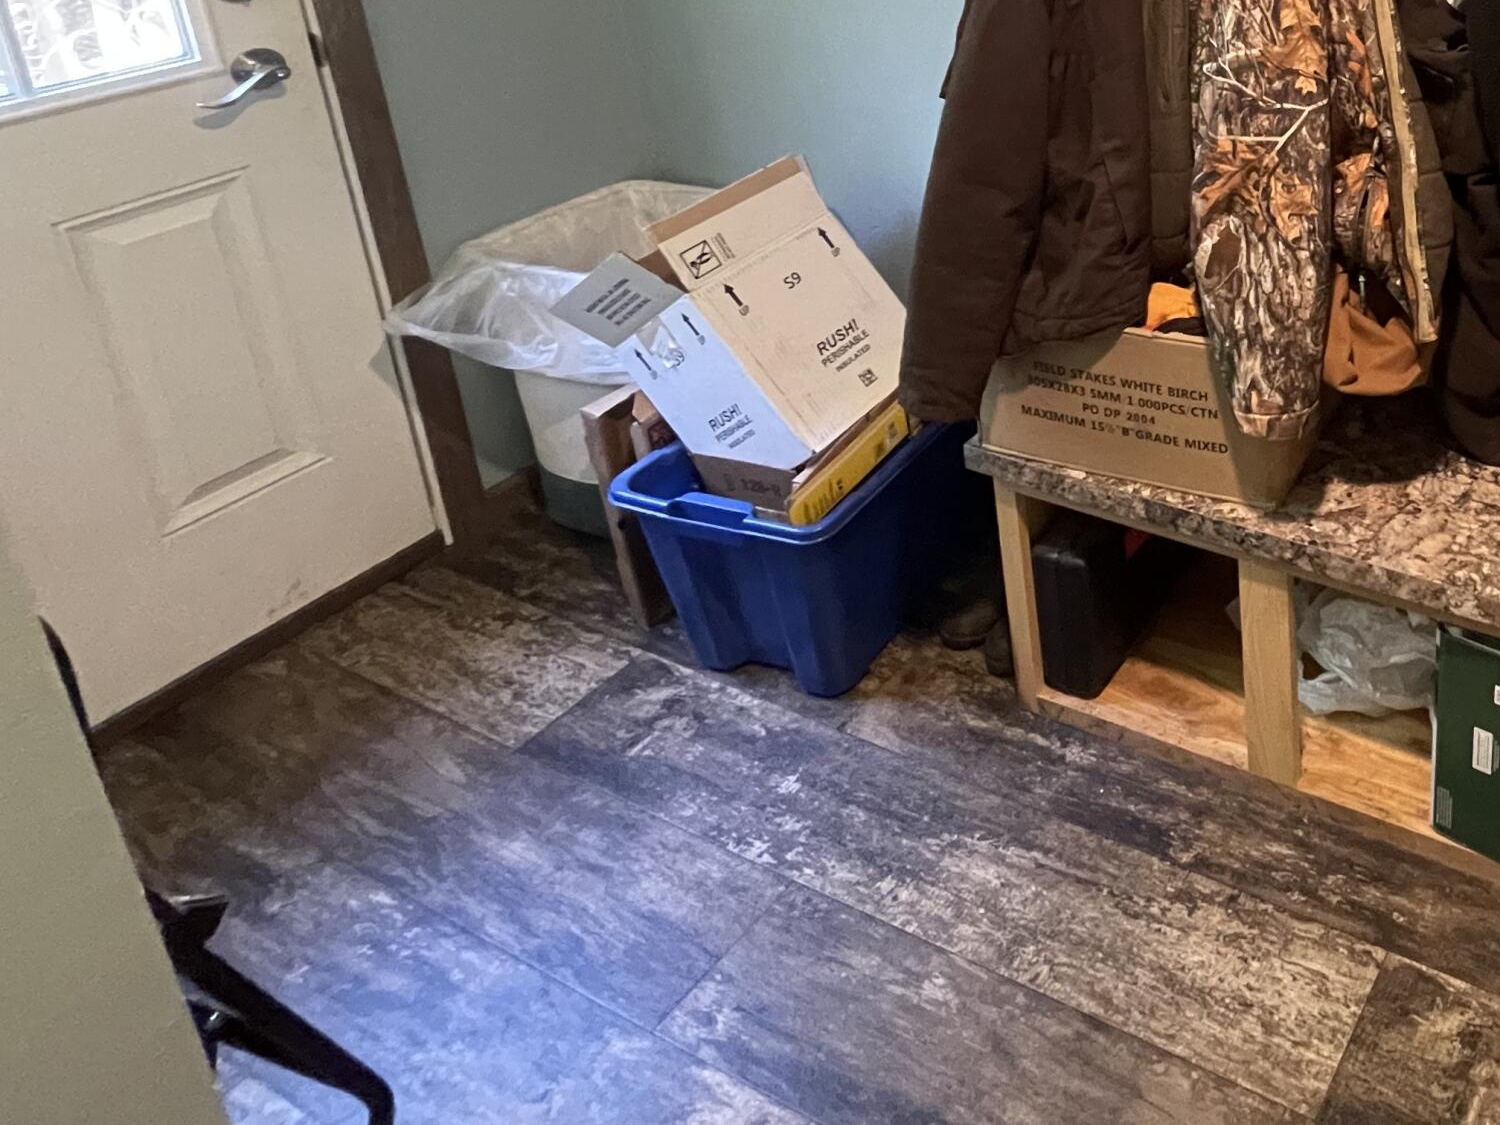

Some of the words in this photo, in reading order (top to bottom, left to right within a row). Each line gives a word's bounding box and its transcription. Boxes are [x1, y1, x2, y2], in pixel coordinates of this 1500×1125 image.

[783, 272, 801, 289] S9
[816, 318, 859, 356] RUSH!
[821, 329, 870, 367] PERISHABLE
[1032, 361, 1066, 376] FIELD
[1069, 368, 1116, 386] STAKES
[1119, 377, 1164, 396] WHITE
[1167, 386, 1208, 402] BIRCH
[708, 403, 743, 432] RUSH!
[1020, 403, 1086, 428] MAXIMUM
[1135, 429, 1181, 447] GRADE
[1184, 438, 1229, 454] MIXED
[1081, 402, 1100, 415] PO
[1103, 407, 1121, 419] DP
